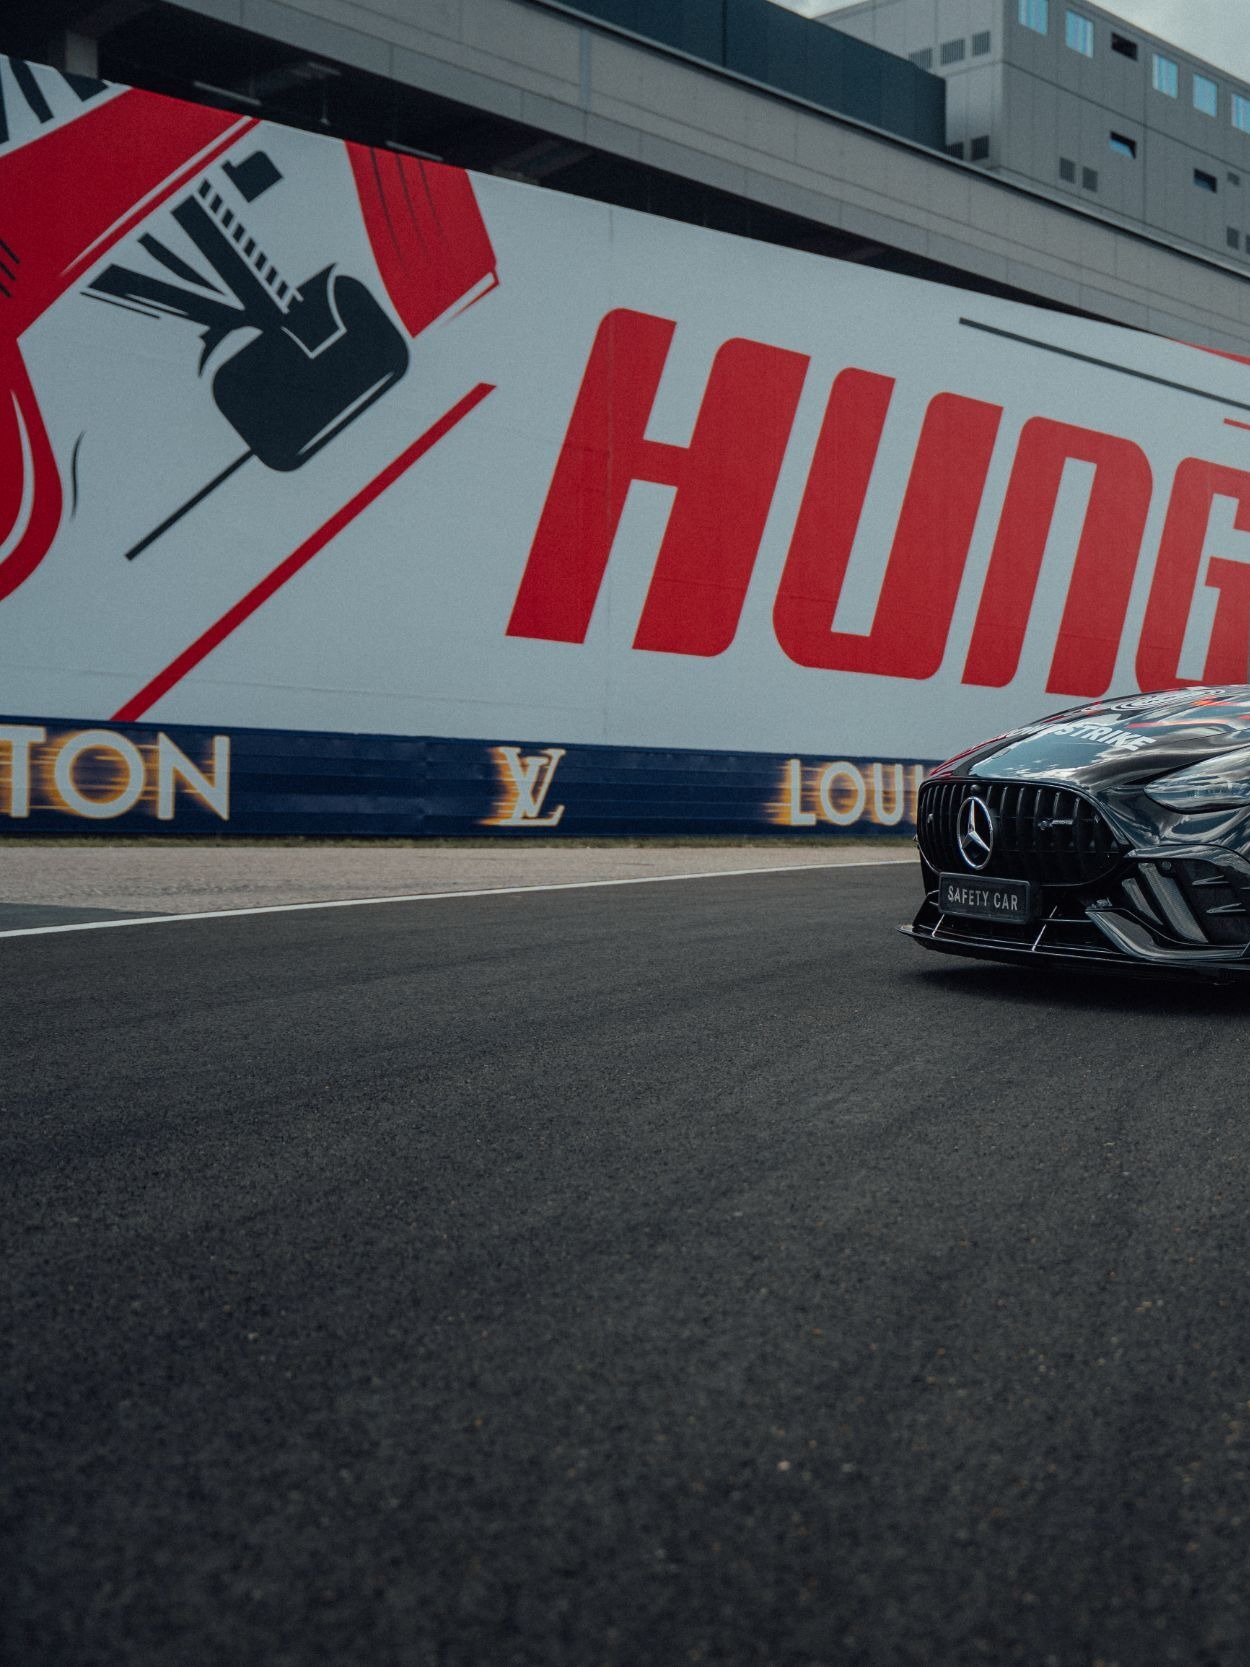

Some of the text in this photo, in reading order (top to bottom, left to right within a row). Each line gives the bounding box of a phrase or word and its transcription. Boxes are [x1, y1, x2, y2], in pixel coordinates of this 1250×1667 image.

[0, 725, 230, 821] TON
[947, 885, 1018, 911] SAFETY CAR
